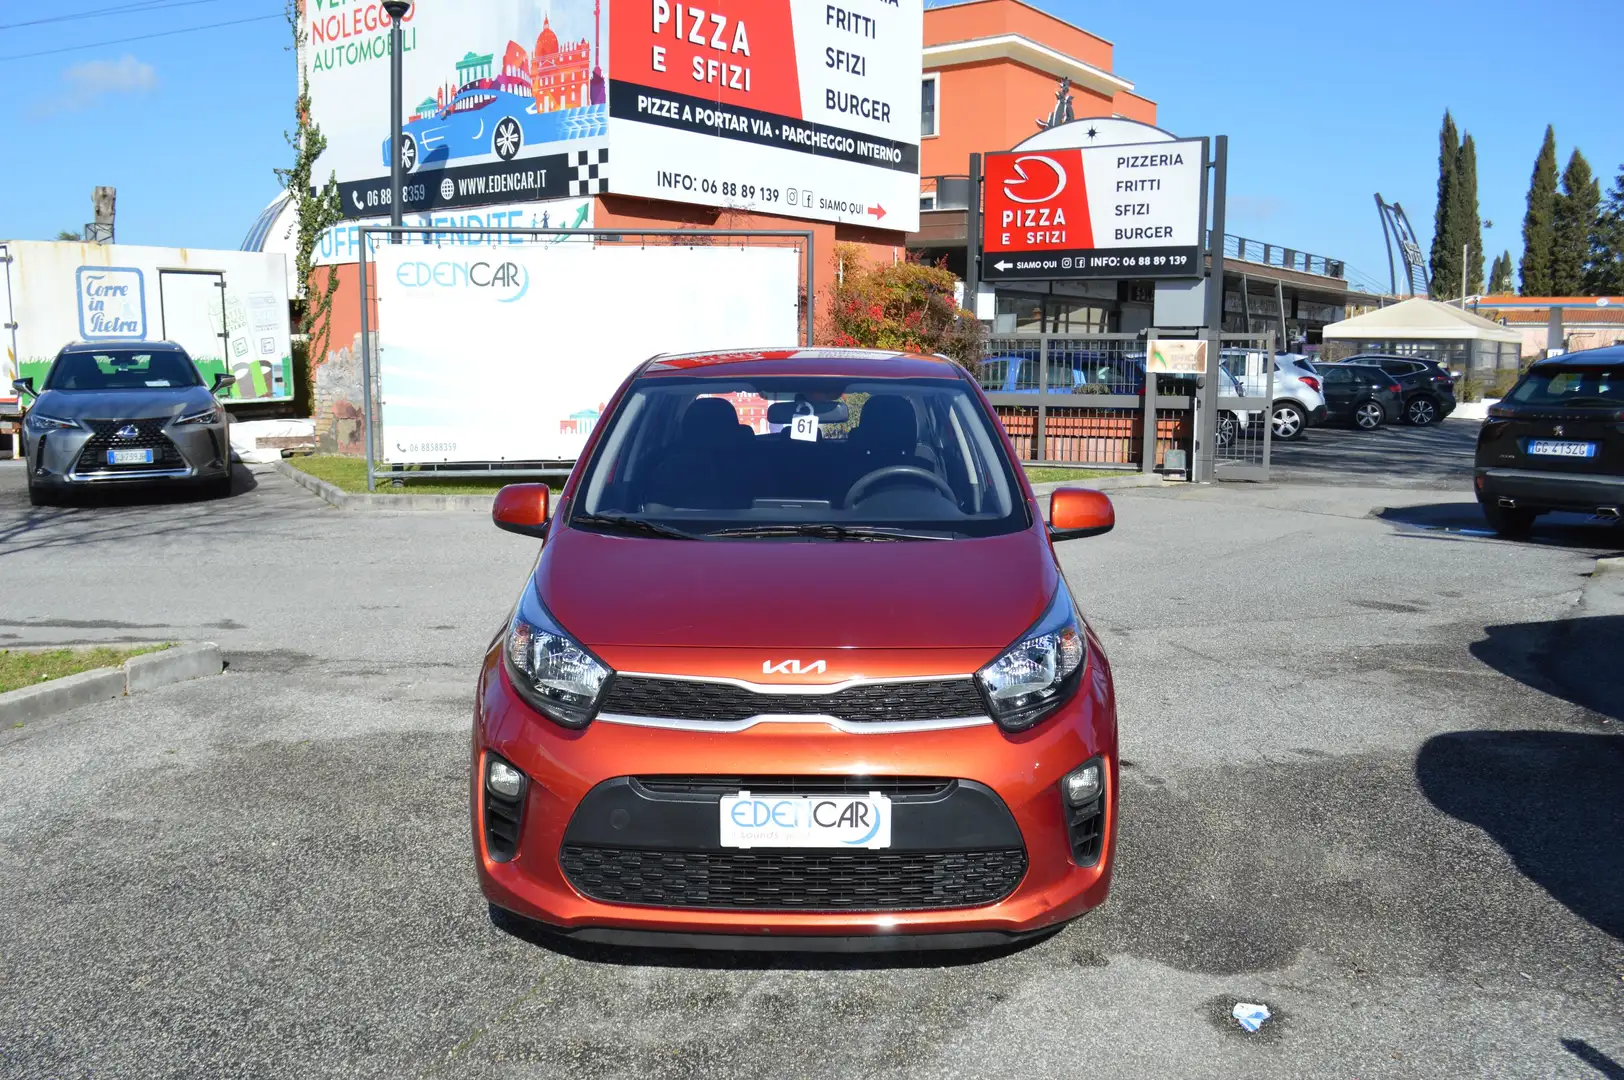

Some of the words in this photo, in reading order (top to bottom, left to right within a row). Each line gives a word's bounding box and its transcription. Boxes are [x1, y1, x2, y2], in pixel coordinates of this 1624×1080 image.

[312, 0, 415, 46] NOLEGGO
[652, 0, 750, 57] PIZZA
[826, 4, 875, 40] FRITTI
[652, 45, 667, 73] E
[692, 55, 750, 92] SFIZI
[825, 46, 866, 77] SFIZI
[826, 88, 891, 123] BURGER
[638, 95, 679, 119] PIZZE
[682, 104, 693, 122] A
[695, 107, 749, 133] PORTAR
[751, 118, 773, 138] VIA
[782, 125, 855, 154] PARCHEGGIO
[857, 140, 902, 163] INTERNO
[1117, 153, 1184, 169] PIZZERIA
[458, 170, 547, 196] WWW.EDENCAR.IT
[657, 170, 697, 192] INFO:
[701, 179, 718, 194] 06
[722, 181, 737, 197] 88
[741, 184, 756, 200] 89
[759, 187, 779, 203] 139
[1116, 179, 1161, 193] FRITTI
[366, 190, 379, 207] 06
[380, 184, 426, 205] 888359
[819, 198, 847, 212] SIAMO
[849, 203, 864, 215] QUI
[1002, 207, 1066, 228] PIZZA
[1115, 203, 1150, 217] SFIZI
[417, 210, 524, 246] VENDITE
[1002, 233, 1011, 245] E
[1026, 230, 1066, 244] SFIZI
[1115, 226, 1173, 241] BURGER
[1016, 261, 1042, 270] SIAMO
[1043, 260, 1057, 270] QUI
[1090, 256, 1120, 267] INFO:
[1122, 257, 1136, 267] 06
[1138, 256, 1151, 266] 88
[1153, 256, 1166, 266] 89
[1169, 255, 1187, 265] 139
[86, 274, 128, 297] Torre
[396, 261, 520, 288] EDENCAR
[88, 297, 105, 312] in
[90, 311, 138, 333] Pietra
[797, 418, 814, 434] 61
[409, 443, 419, 453] 06
[421, 442, 457, 453] 88588359
[1535, 441, 1547, 453] GG
[762, 659, 827, 674] KIA
